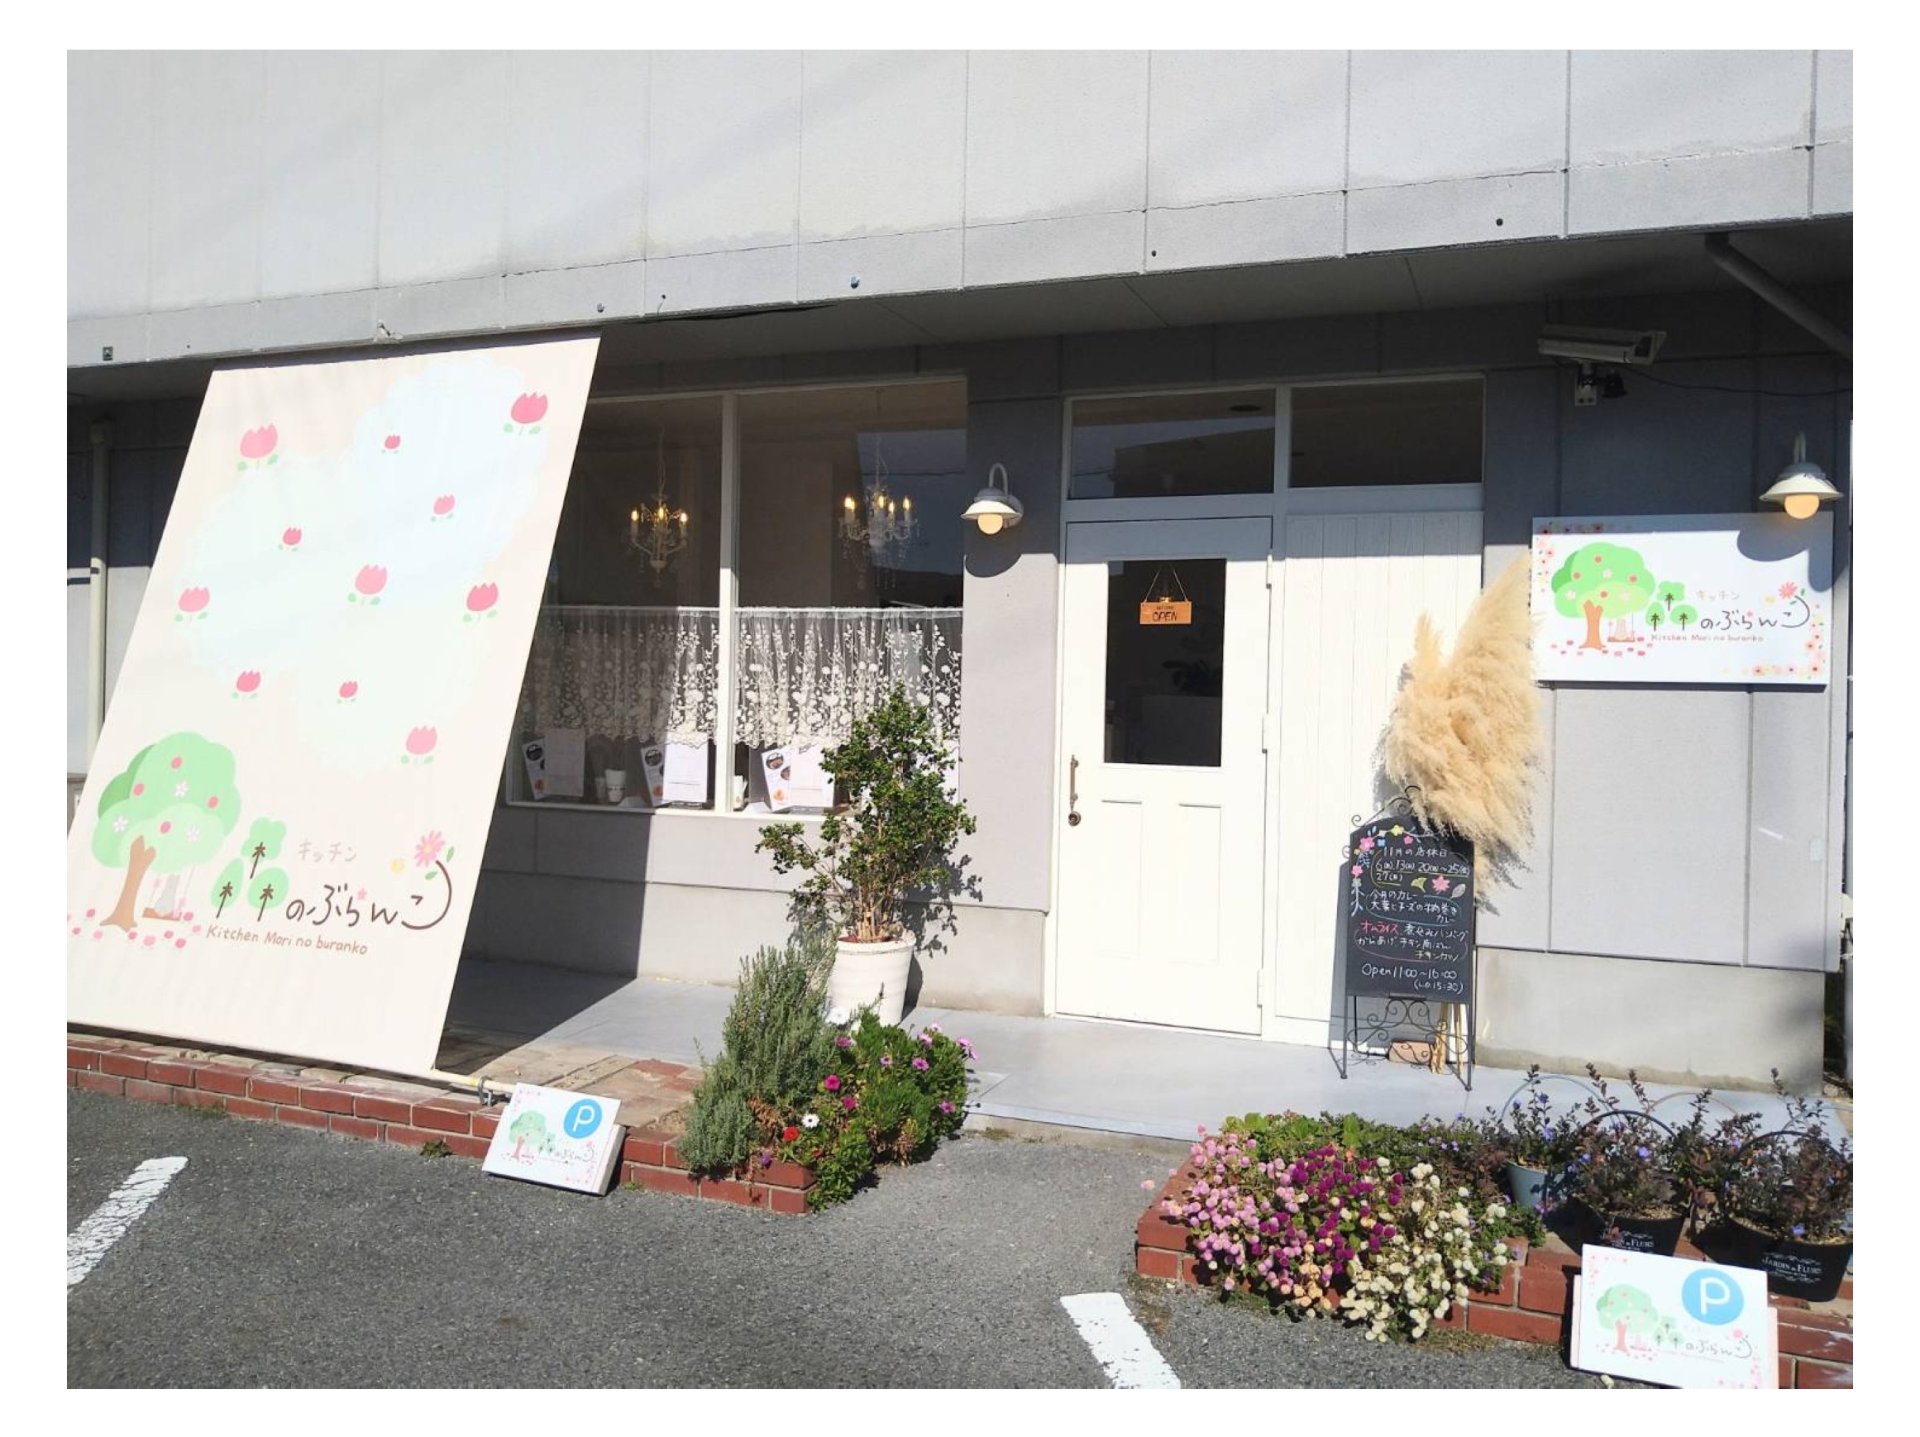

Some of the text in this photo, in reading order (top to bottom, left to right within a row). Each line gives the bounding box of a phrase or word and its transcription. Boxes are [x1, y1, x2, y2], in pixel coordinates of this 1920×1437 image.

[1152, 610, 1177, 622] OPEN
[1651, 633, 1687, 641] Kitchen
[298, 838, 357, 864] キッチン
[206, 924, 259, 943] Kitchen
[295, 936, 312, 948] no
[316, 935, 368, 956] buranko
[572, 1105, 596, 1132] P
[1700, 1276, 1731, 1316] P
